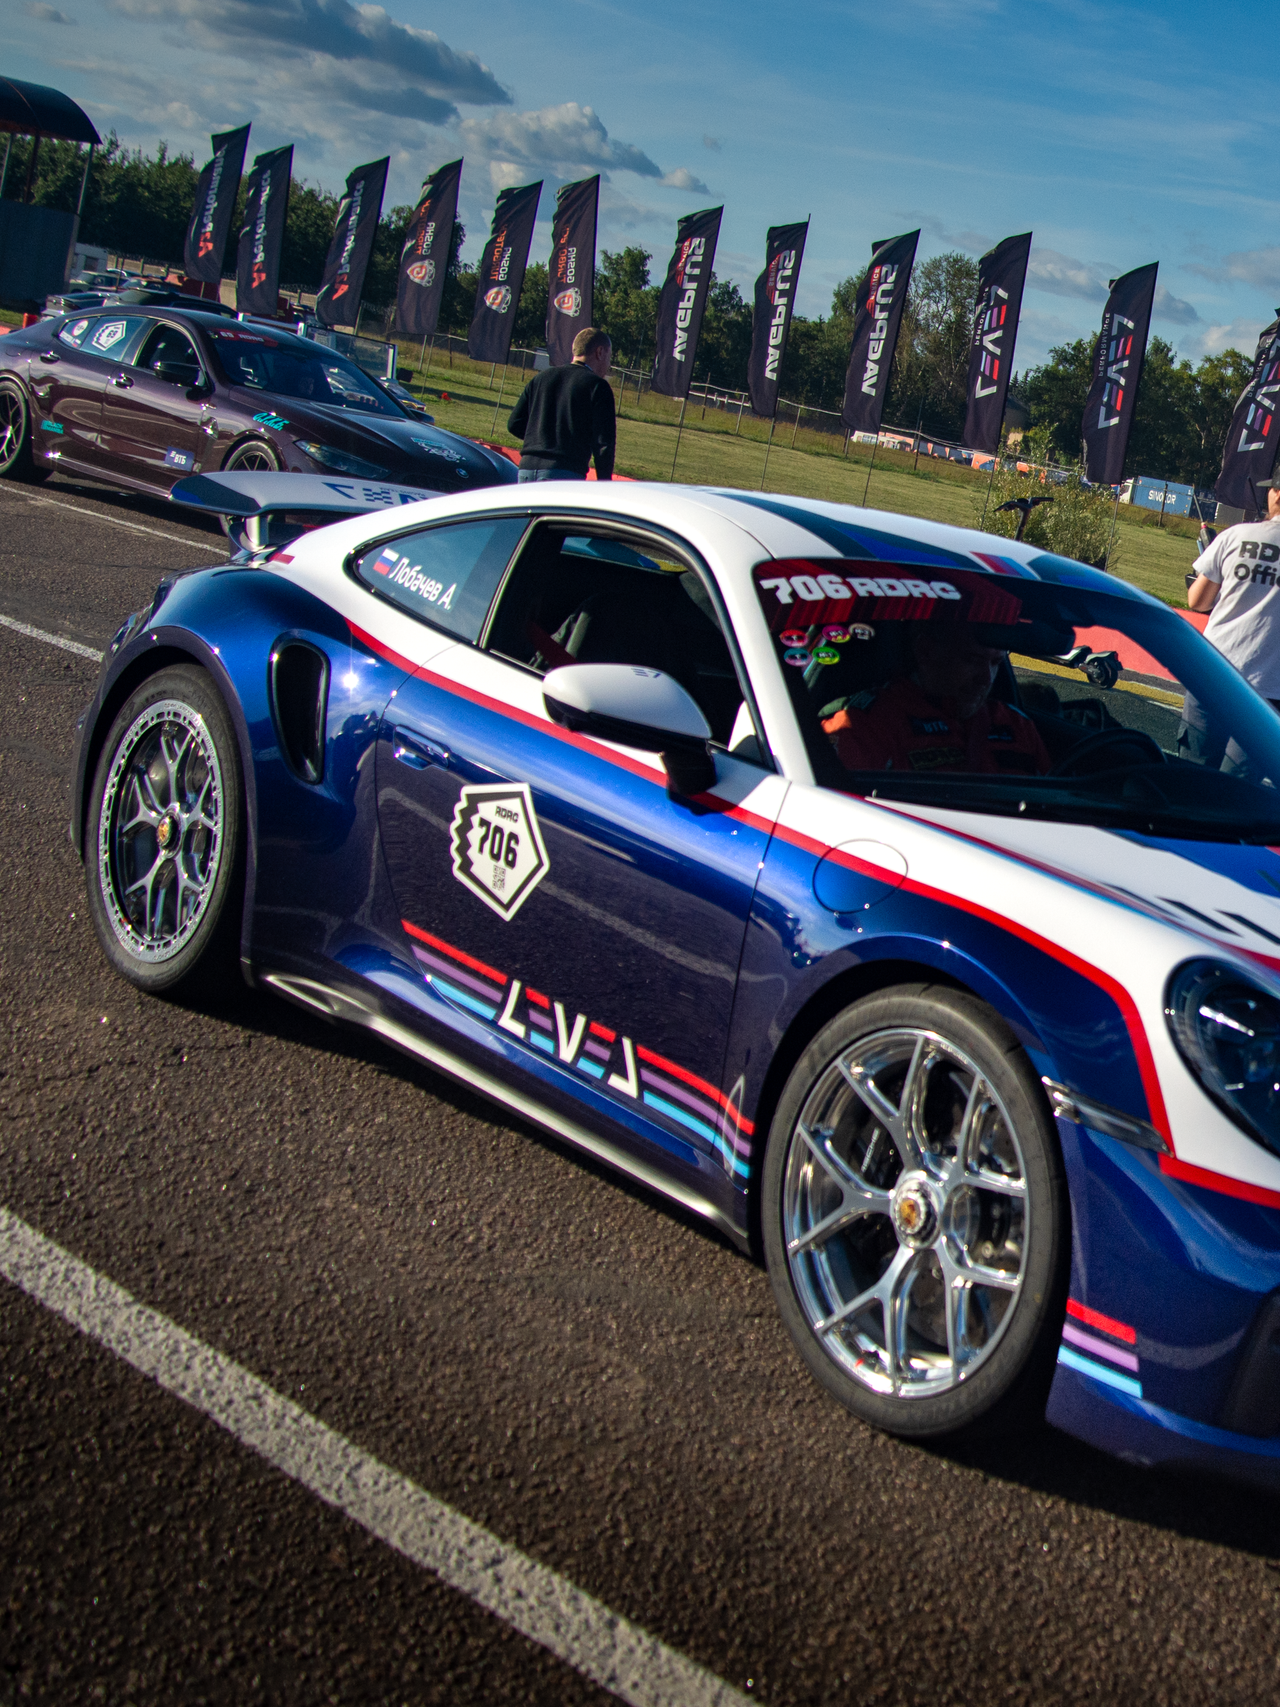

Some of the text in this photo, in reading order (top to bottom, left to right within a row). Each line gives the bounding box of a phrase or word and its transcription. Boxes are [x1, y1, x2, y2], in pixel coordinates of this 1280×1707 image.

[174, 453, 187, 464] ВТБ
[1148, 490, 1177, 505] SINOOR
[388, 557, 443, 602] Лобачев
[759, 574, 962, 604] 706 RDRC
[495, 806, 519, 823] RDRC
[478, 817, 520, 870] 706
